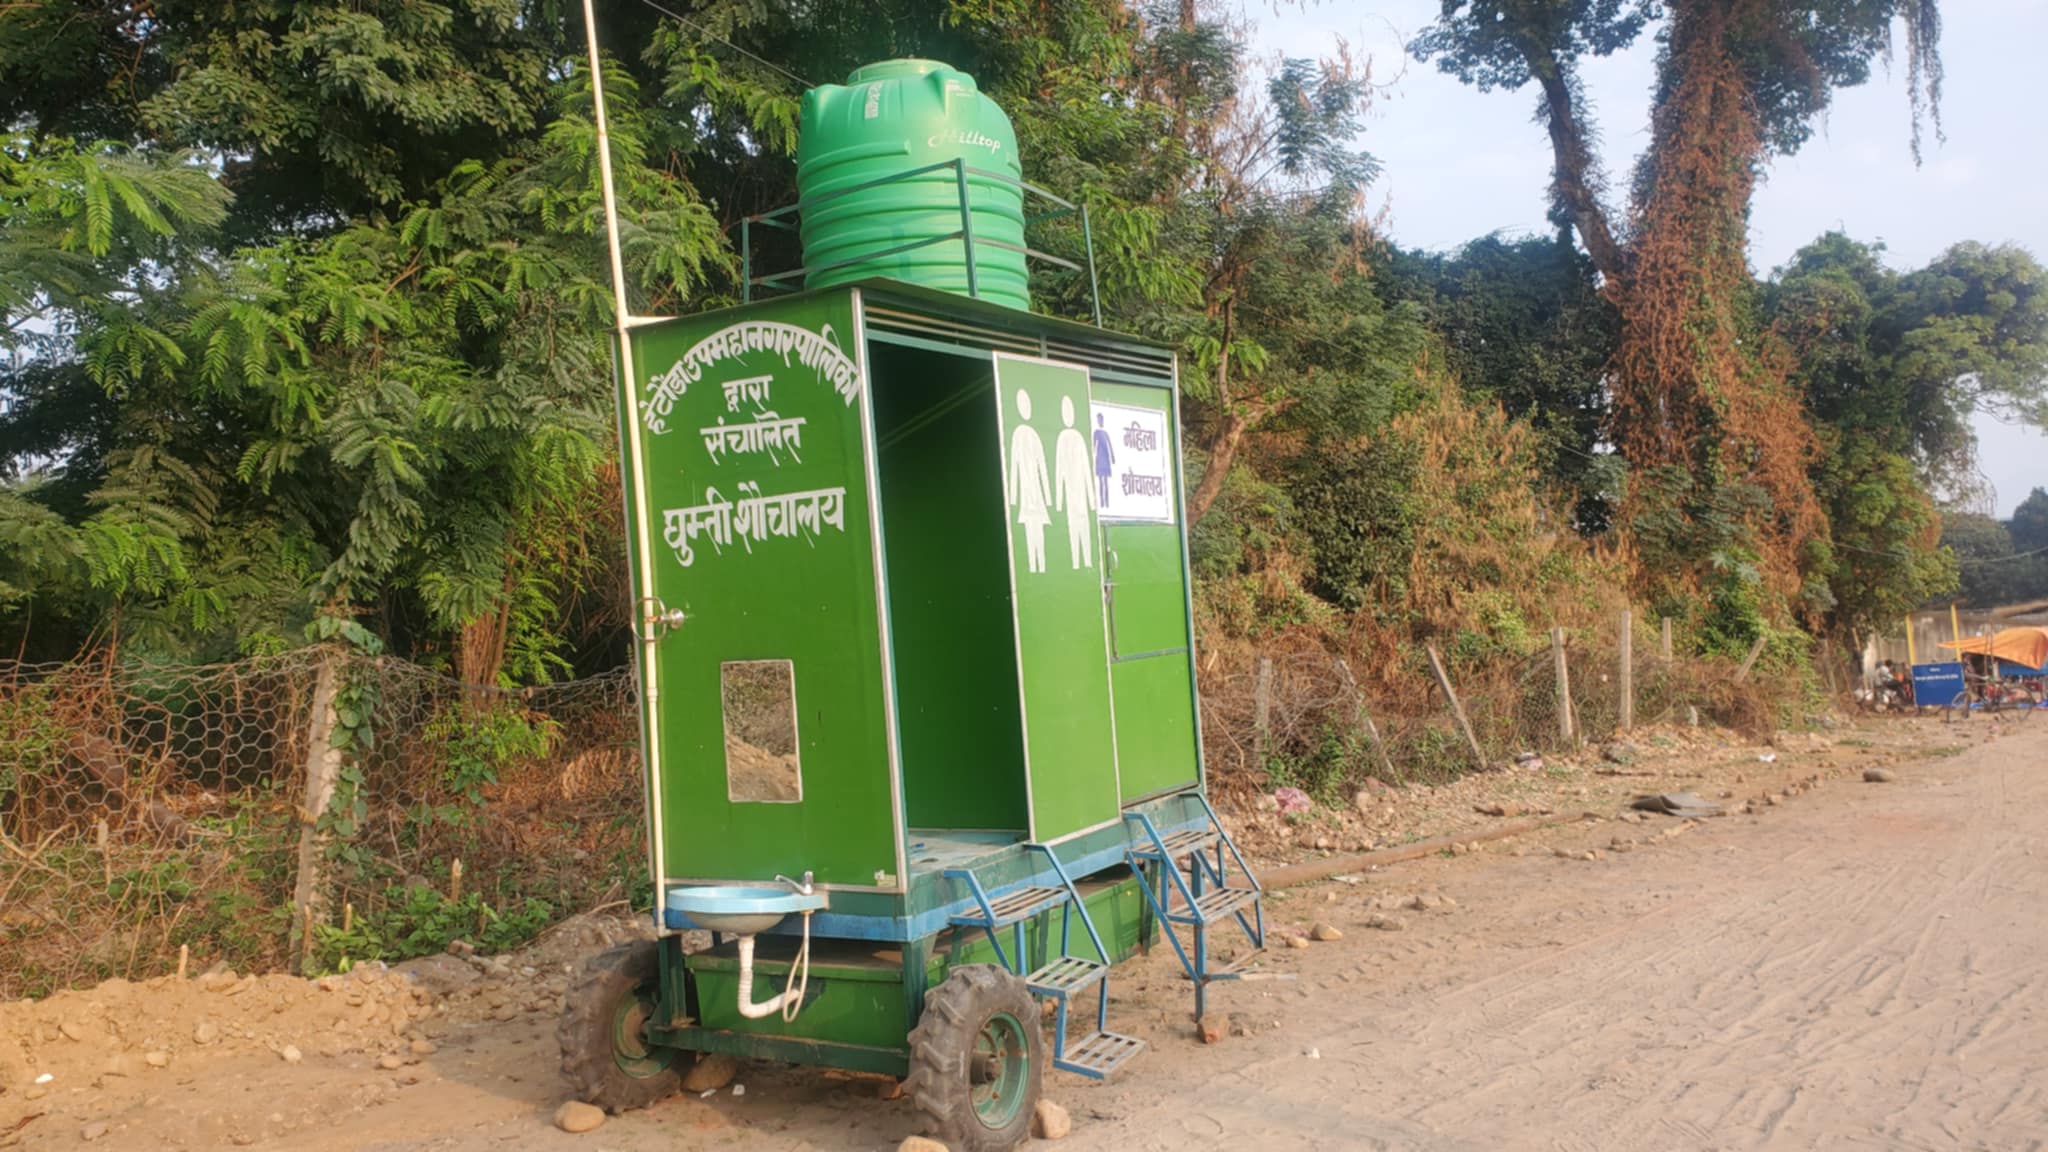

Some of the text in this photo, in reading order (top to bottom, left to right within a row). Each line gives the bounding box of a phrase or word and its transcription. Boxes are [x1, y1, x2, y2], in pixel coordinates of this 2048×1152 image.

[721, 374, 774, 413] द्वारा
[700, 411, 807, 467] संचालित
[1122, 420, 1157, 452] महिला
[662, 480, 847, 568] घुम्ती शौचालय
